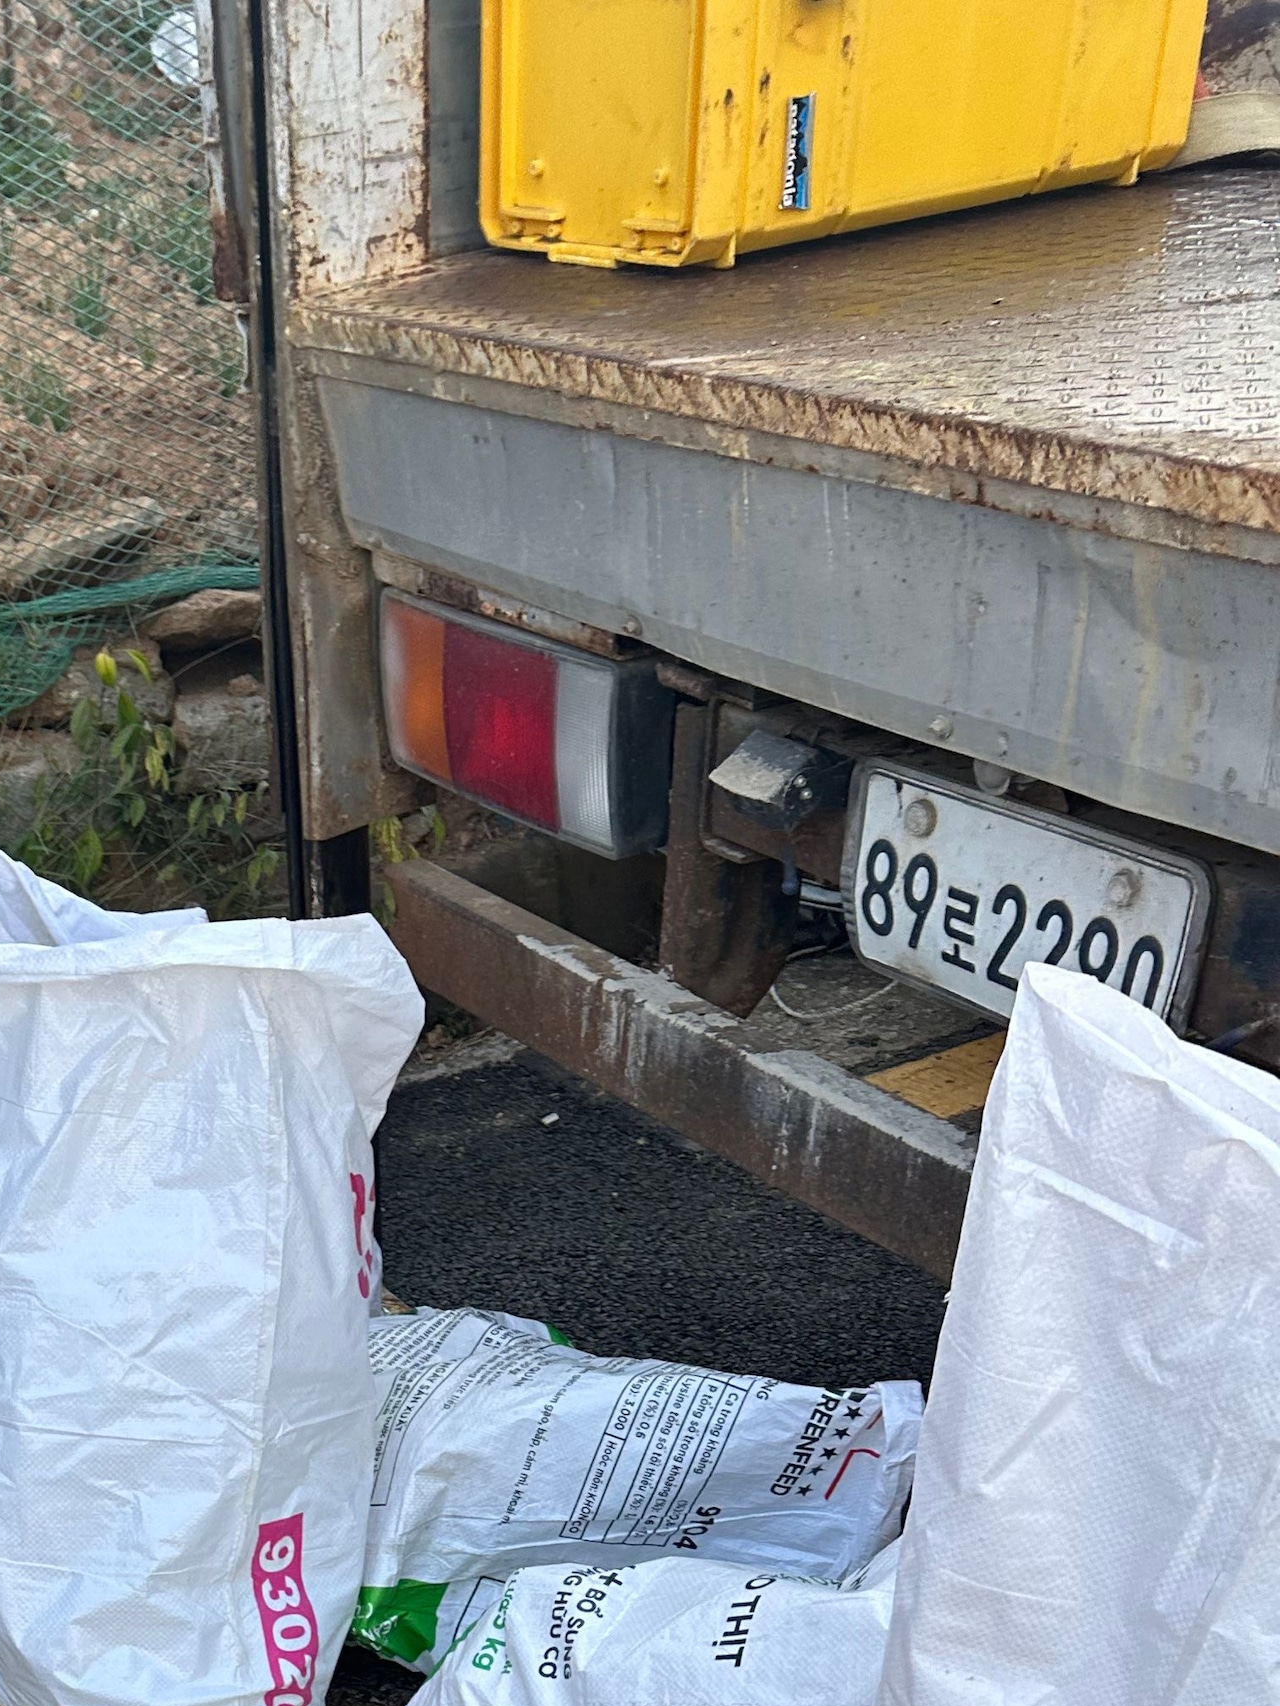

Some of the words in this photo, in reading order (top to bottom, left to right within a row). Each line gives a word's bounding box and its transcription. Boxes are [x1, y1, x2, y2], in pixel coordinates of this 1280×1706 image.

[782, 103, 798, 206] patagonia
[673, 1378, 697, 1409] Lysine
[727, 1391, 739, 1408] Ca
[614, 1399, 637, 1431] 3.000
[635, 1421, 651, 1440] 0,6
[709, 1408, 732, 1440] trong
[673, 1433, 695, 1465] trong
[693, 1440, 717, 1476] khoảng
[659, 1465, 682, 1498] khoảng
[673, 1505, 721, 1550] 9104
[550, 1591, 573, 1639] HỮU
[576, 1587, 608, 1619] BỔ
[711, 1594, 761, 1668] THỊT
[472, 1637, 507, 1672] kg
[538, 1646, 560, 1680] CƠ
[563, 1616, 586, 1680] SUNG
